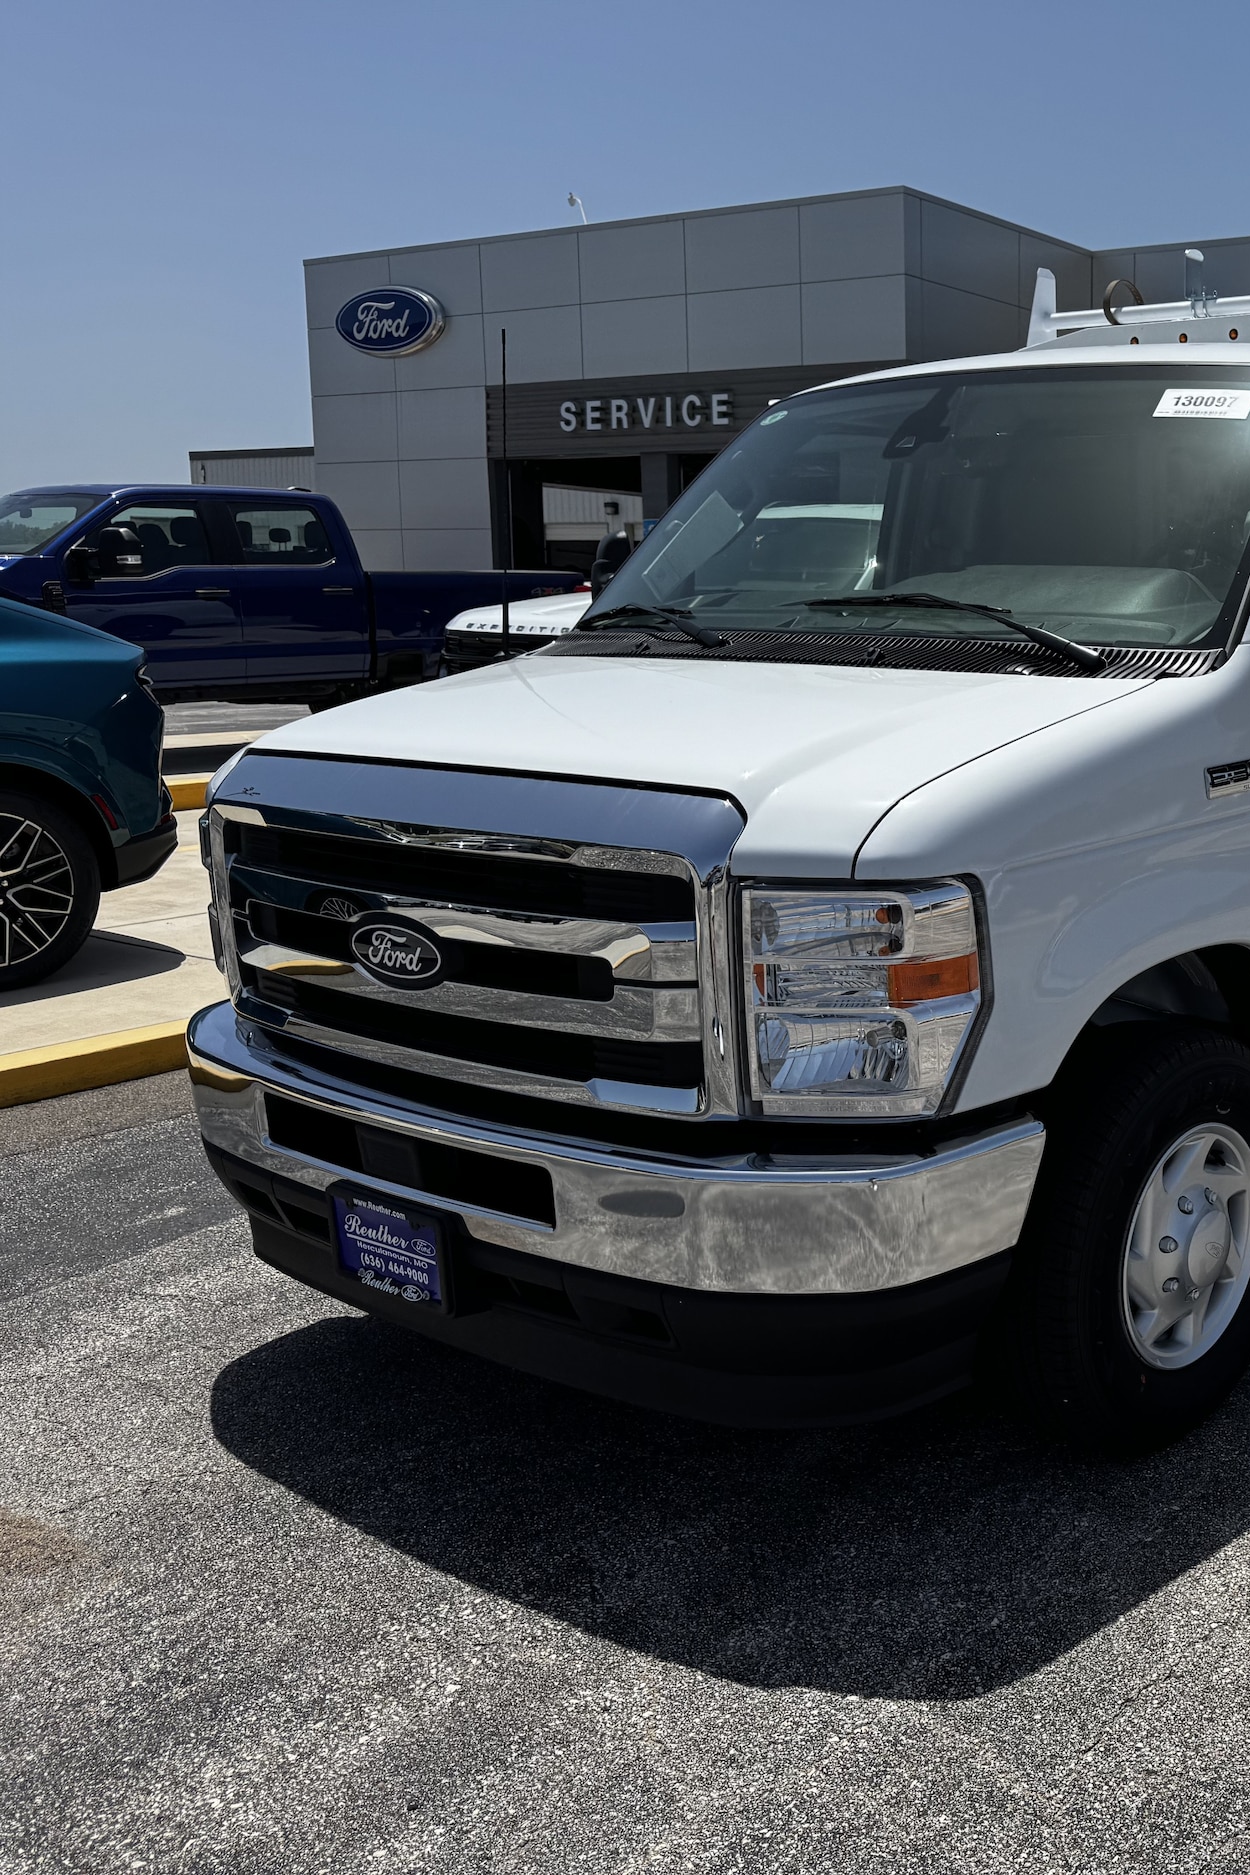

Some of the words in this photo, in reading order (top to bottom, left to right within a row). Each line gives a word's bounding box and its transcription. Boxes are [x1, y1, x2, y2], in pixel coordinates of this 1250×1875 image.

[353, 301, 410, 340] Ford
[560, 393, 731, 432] SERVICE
[1173, 395, 1240, 408] 130097
[368, 930, 422, 972] Ford
[353, 1198, 406, 1221] www.Reuther.com
[344, 1213, 410, 1249] Reuther
[360, 1252, 386, 1273] (636)
[388, 1261, 429, 1285] 464-9000
[414, 1258, 428, 1269] MO
[361, 1270, 401, 1296] Reuther
